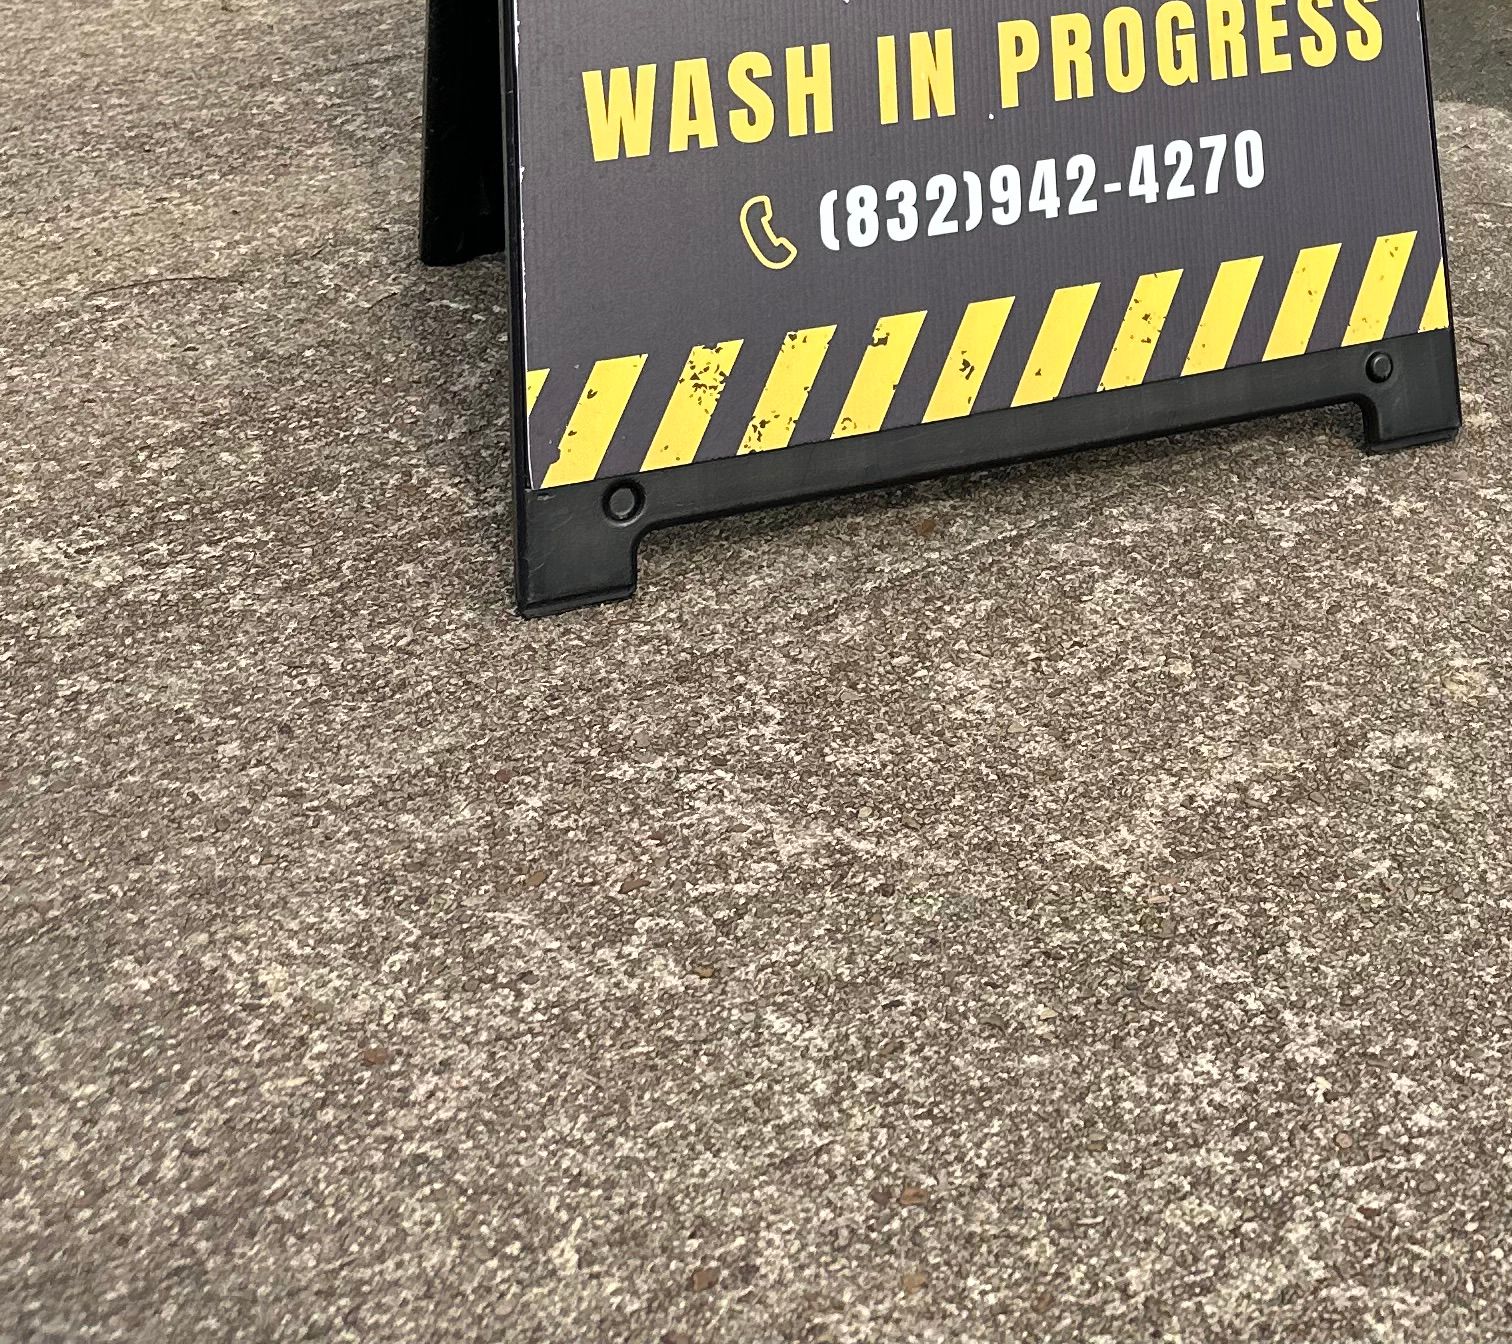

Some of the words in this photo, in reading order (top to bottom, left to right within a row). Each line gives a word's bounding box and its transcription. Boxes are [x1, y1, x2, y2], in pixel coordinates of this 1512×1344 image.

[582, 42, 834, 162] WASH
[877, 28, 956, 125] IN
[819, 129, 1265, 251] (832)942-4270
